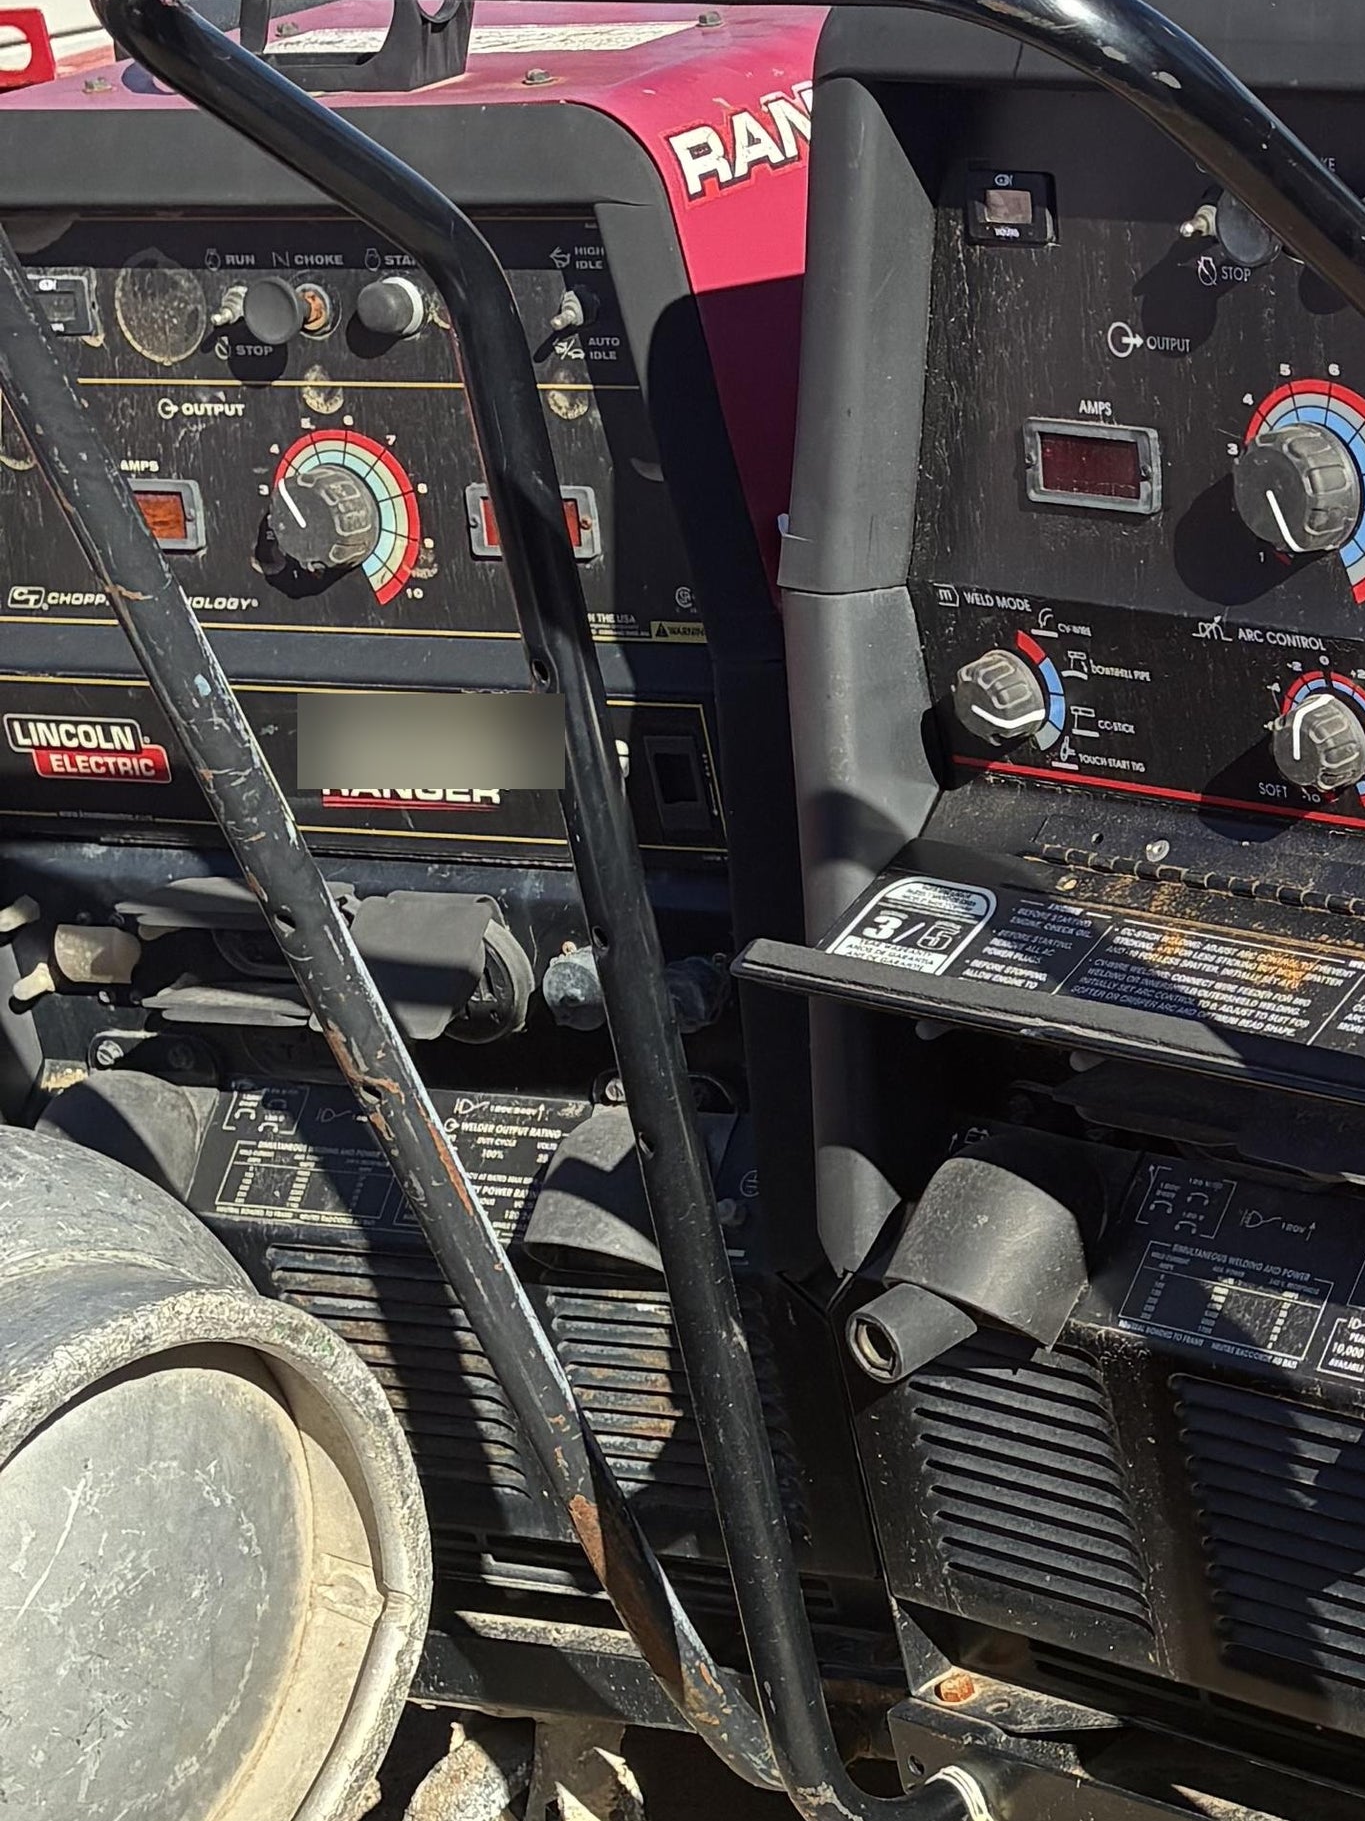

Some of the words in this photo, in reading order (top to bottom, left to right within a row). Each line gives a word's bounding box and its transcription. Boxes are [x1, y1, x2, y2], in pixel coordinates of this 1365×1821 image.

[668, 88, 814, 196] RAN
[574, 245, 605, 256] HIGH
[225, 254, 256, 266] RUN
[294, 254, 344, 266] CHOKE
[384, 254, 418, 266] STA
[575, 259, 604, 270] IDLE
[1221, 266, 1251, 282] STOP
[588, 336, 621, 347] AUTO
[1146, 335, 1192, 353] OUTPUT
[235, 344, 274, 356] STOP
[589, 350, 617, 360] IDLE
[1279, 364, 1291, 377] 5
[1328, 363, 1340, 377] 6
[1242, 393, 1254, 406] 4
[181, 402, 246, 417] OUTPUT
[1078, 399, 1113, 416] AMPS
[1227, 443, 1239, 456] 3
[119, 459, 160, 472] AMPS
[405, 587, 424, 600] 10
[47, 591, 110, 607] CHOPP
[187, 596, 251, 611] NOLOGY
[963, 591, 995, 608] WELD
[994, 595, 1033, 613] MODE
[1237, 627, 1265, 644] ARC
[1265, 630, 1328, 652] CONTROL
[13, 720, 136, 751] LINCOLN
[49, 753, 155, 777] ELECTRIC
[1257, 782, 1289, 799] SOFT
[1331, 1341, 1365, 1360] 10,000
